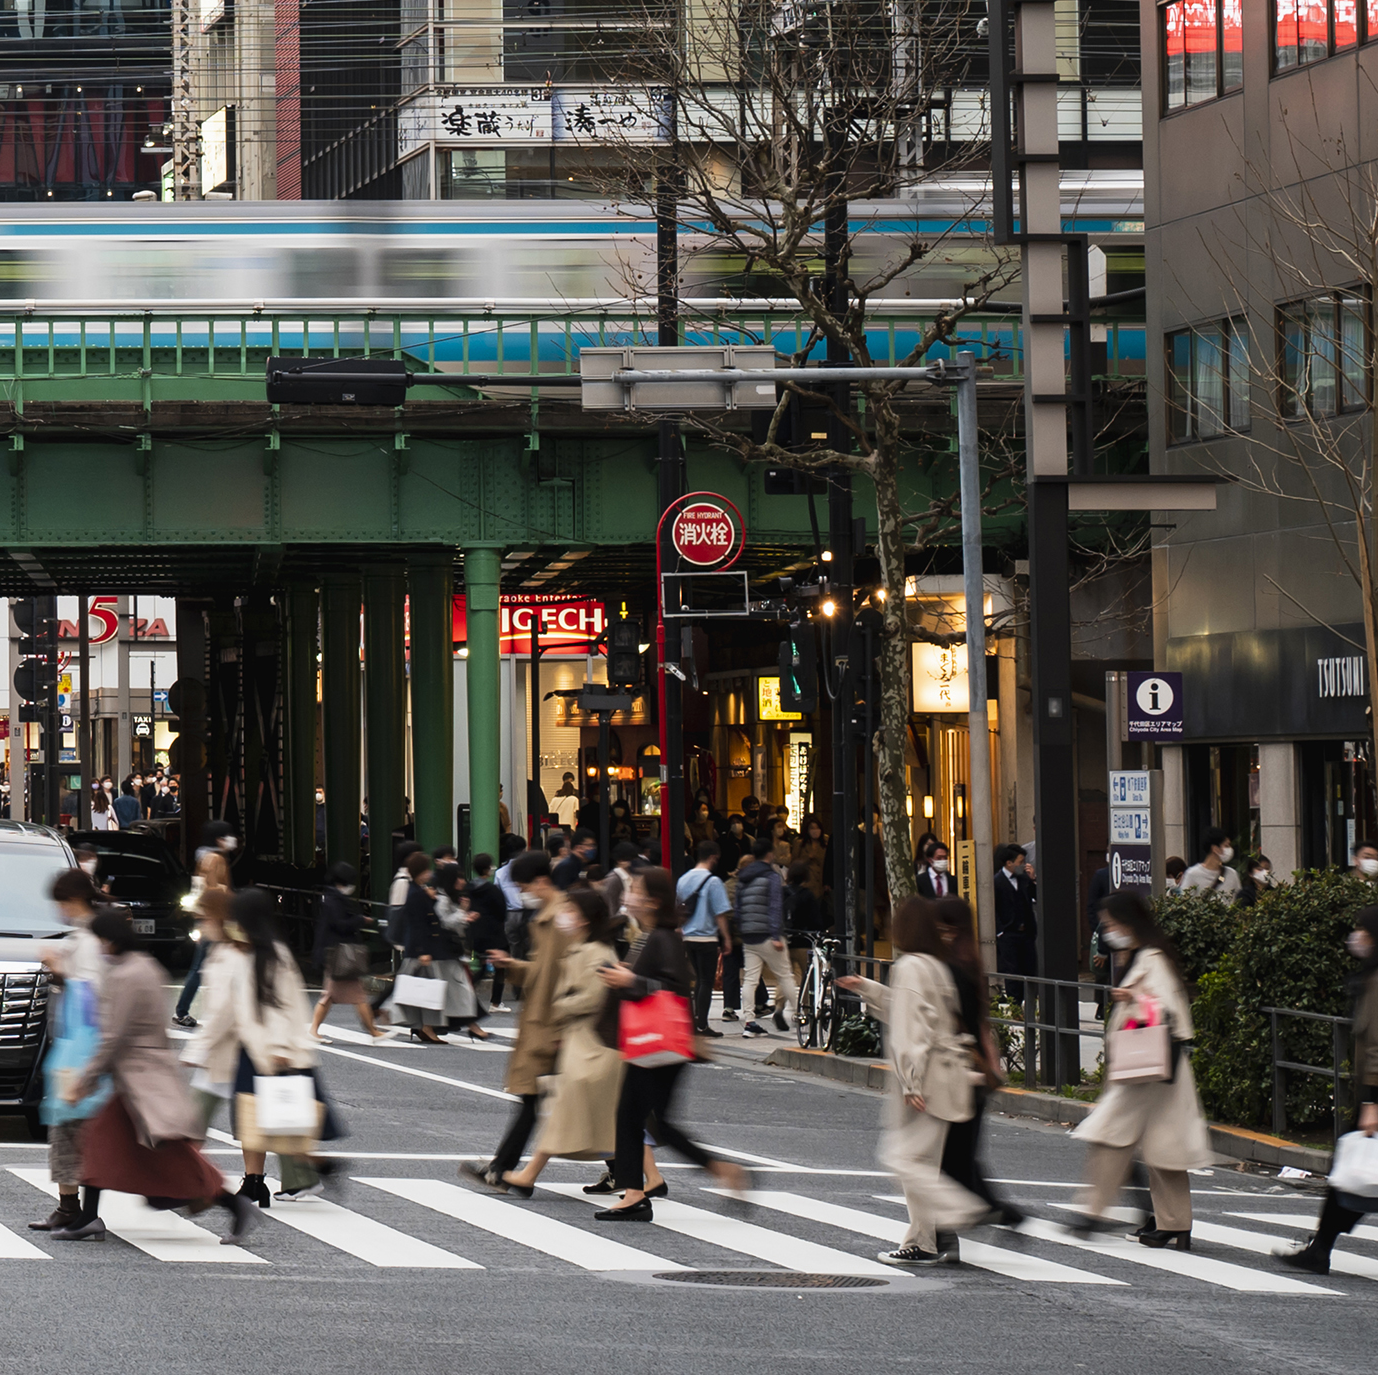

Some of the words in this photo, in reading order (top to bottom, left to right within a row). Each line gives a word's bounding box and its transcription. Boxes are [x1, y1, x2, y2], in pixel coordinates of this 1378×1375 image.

[683, 511, 696, 519] FIRE
[696, 511, 723, 519] HYDRANT
[679, 522, 729, 546] 消火栓
[501, 607, 534, 633] IG
[541, 607, 609, 633] ECH
[133, 715, 152, 723] TAXI
